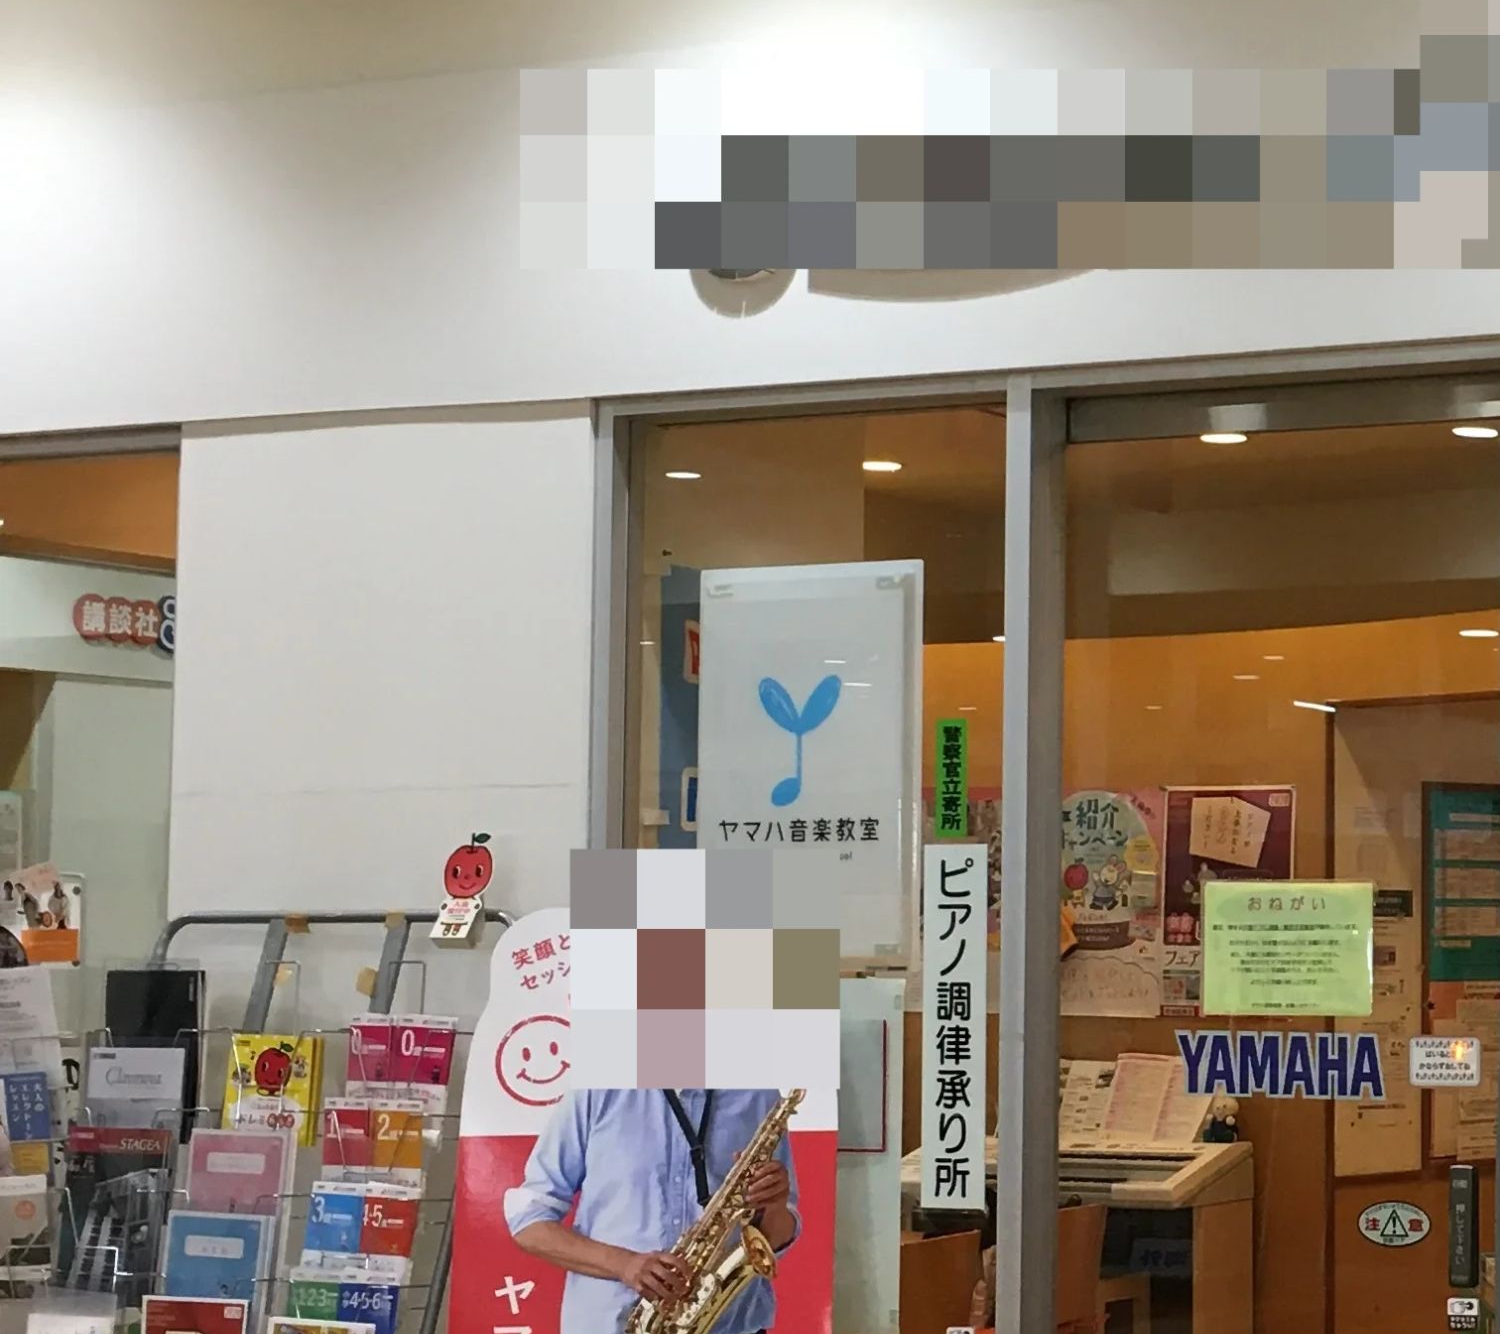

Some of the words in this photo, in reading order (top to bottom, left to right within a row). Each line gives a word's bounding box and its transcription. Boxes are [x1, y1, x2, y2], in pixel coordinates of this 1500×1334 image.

[940, 725, 963, 831] 警察官立寄所
[718, 817, 880, 844] ヤマハ音楽教室
[1248, 895, 1326, 911] おねがい
[934, 857, 974, 1198] ピアノ調律承り所
[1175, 1031, 1386, 1099] YAMAHA
